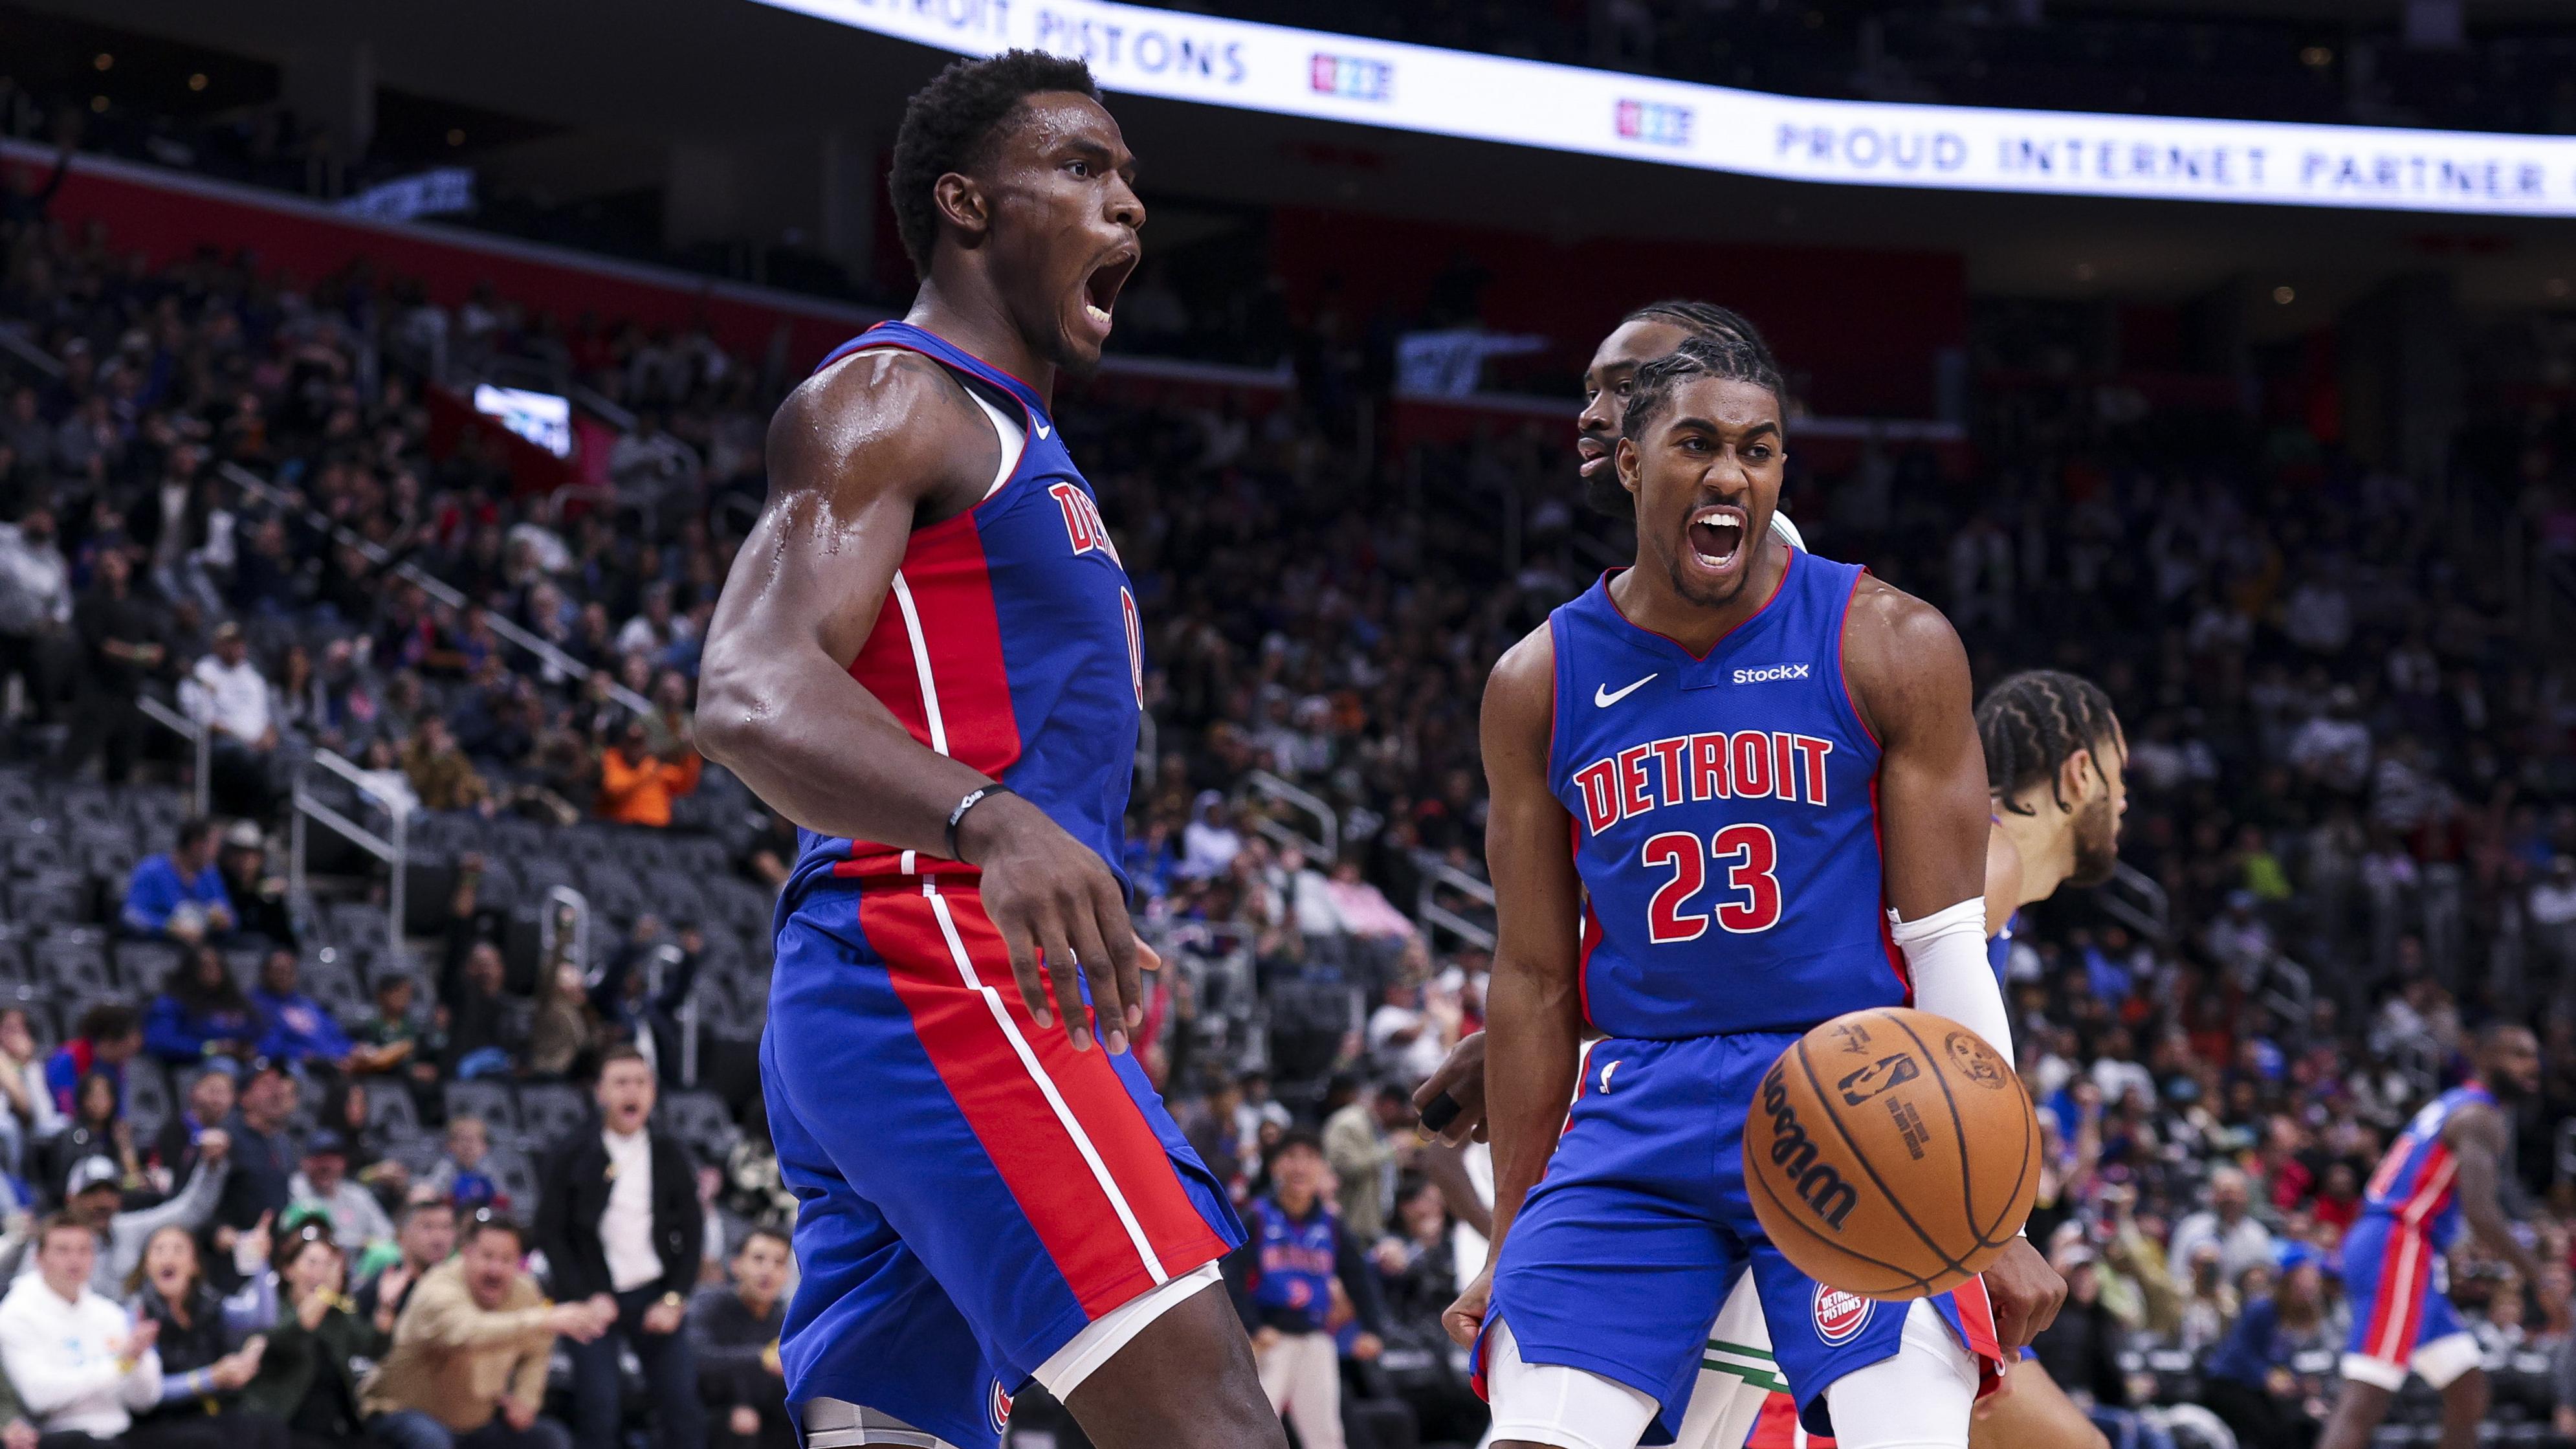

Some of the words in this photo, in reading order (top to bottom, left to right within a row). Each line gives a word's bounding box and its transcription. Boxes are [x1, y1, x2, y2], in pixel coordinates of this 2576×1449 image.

[1037, 8, 1248, 85] PISTONS
[1776, 121, 1969, 171] PROUD
[1998, 137, 2267, 186] INTERNET
[2300, 149, 2546, 199] PARTNER
[1733, 664, 1809, 683] StockX
[1573, 730, 1833, 837] DETROIT
[1642, 823, 1781, 944] 23
[1764, 1057, 1858, 1233] Wilson
[1822, 1296, 1861, 1323] PISTONS
